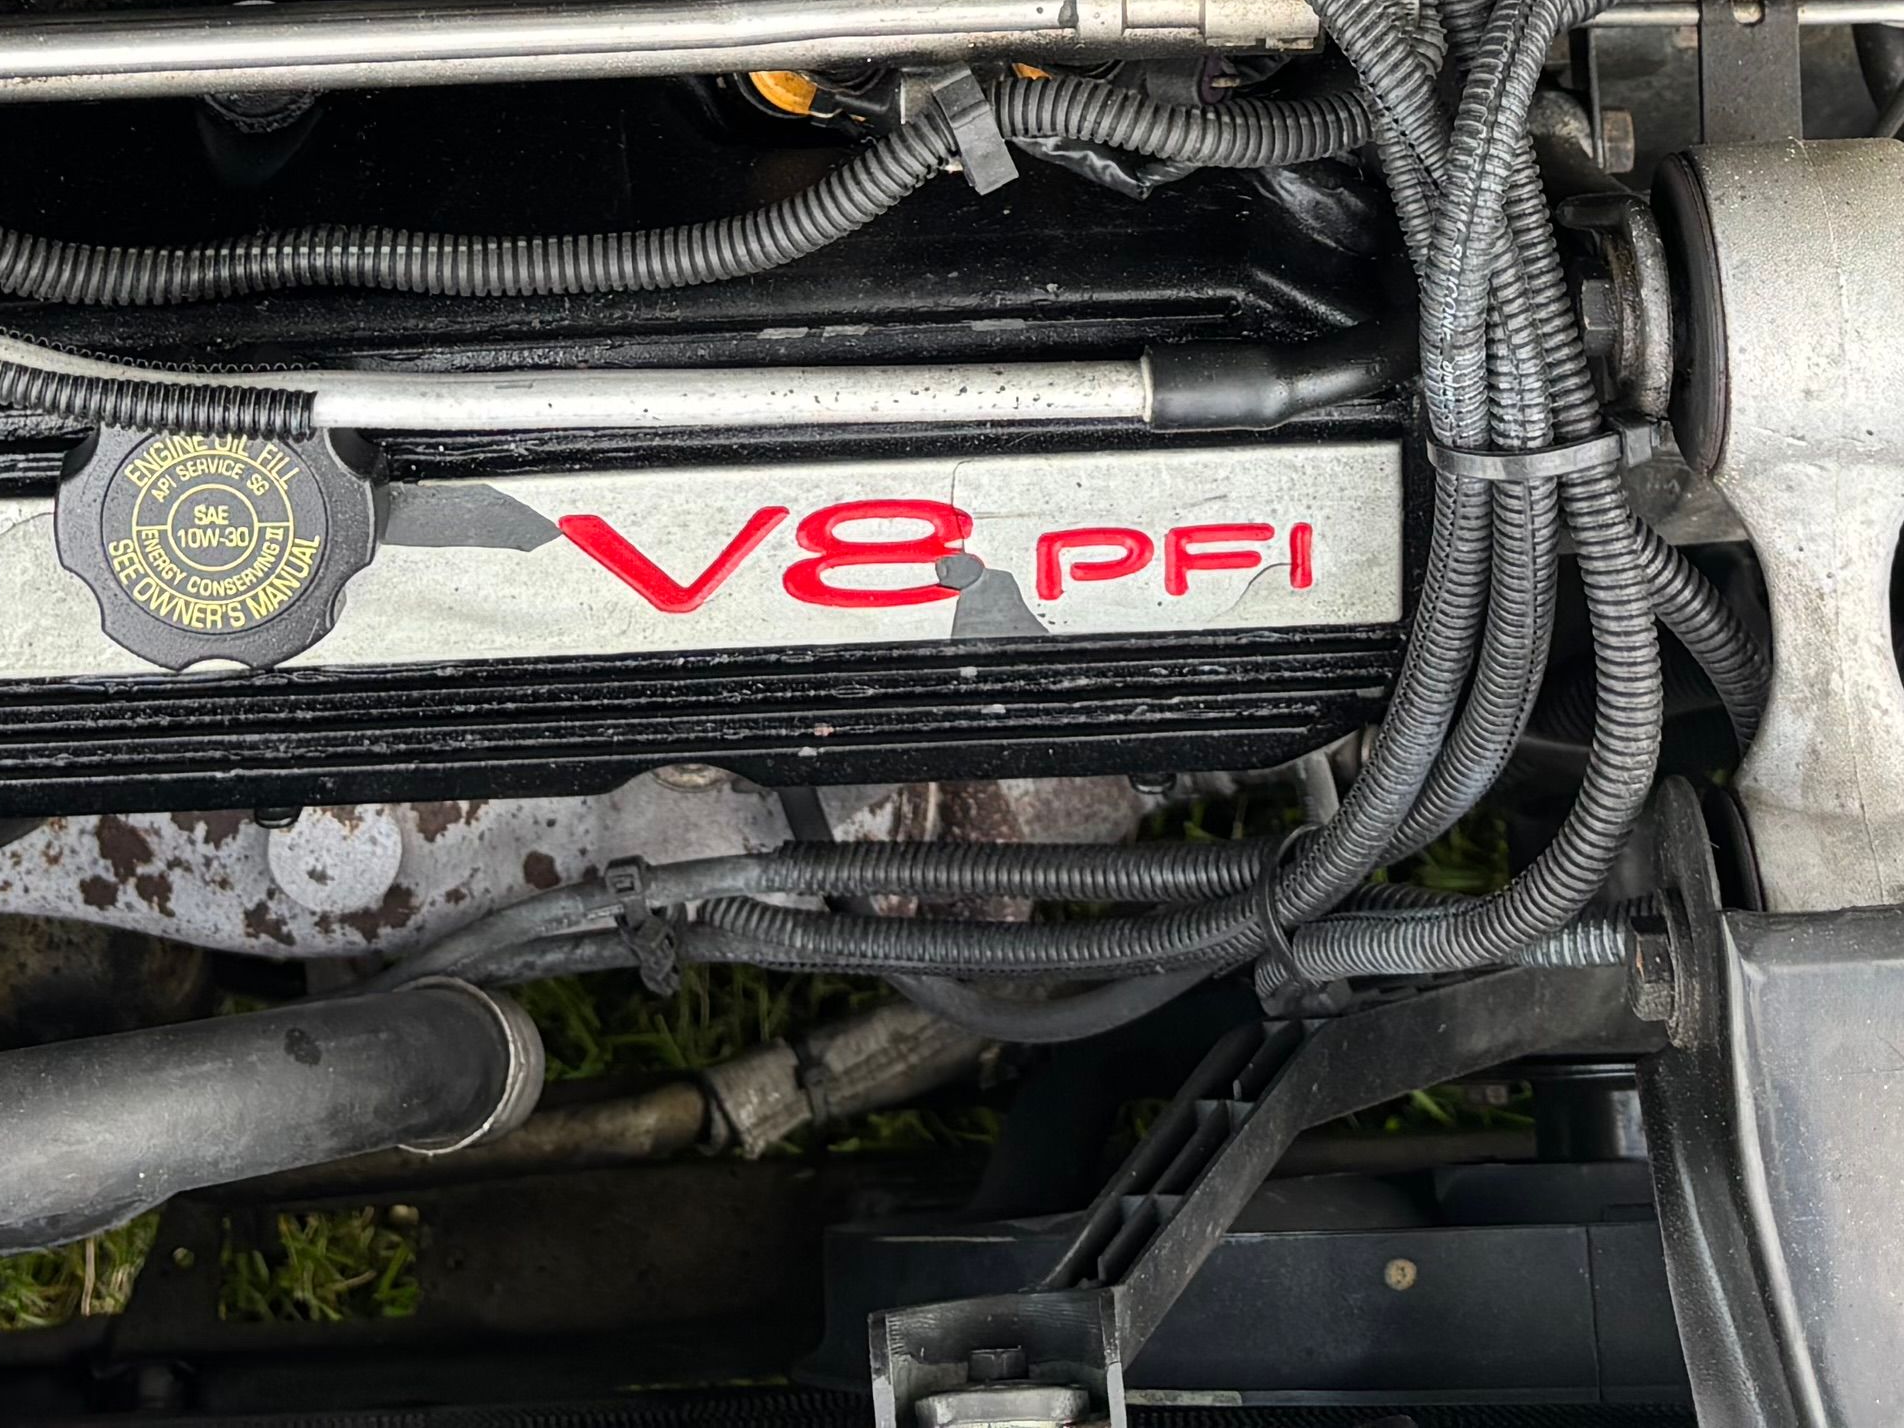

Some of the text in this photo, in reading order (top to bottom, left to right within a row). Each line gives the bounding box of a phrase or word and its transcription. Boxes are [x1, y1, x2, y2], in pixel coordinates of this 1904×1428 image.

[124, 434, 300, 491] ENGINE OIL FILL
[151, 458, 270, 503] API SERVICE SG
[177, 527, 250, 549] 10W-30
[193, 504, 230, 526] SAE
[108, 534, 322, 630] SEE OWNER'S MANUAL
[141, 529, 187, 586] ENERGY
[187, 540, 277, 598] CONSERVING
[558, 498, 1314, 613] V8 PFI
